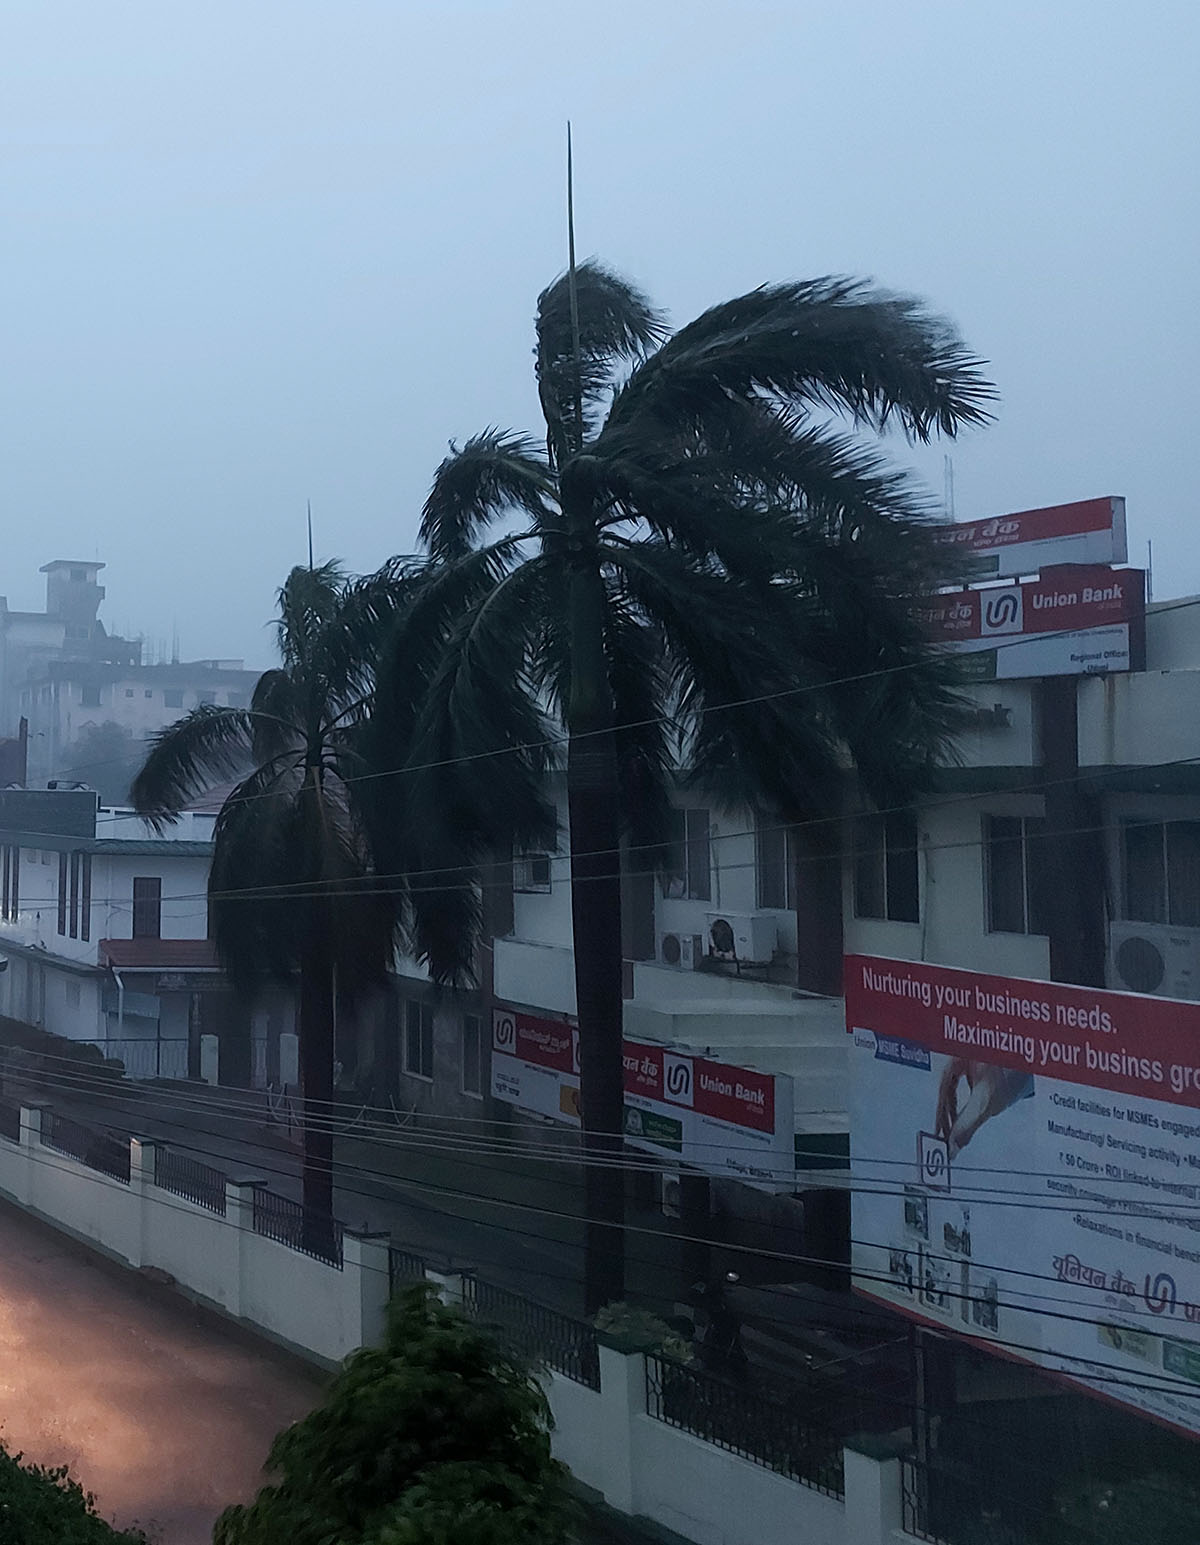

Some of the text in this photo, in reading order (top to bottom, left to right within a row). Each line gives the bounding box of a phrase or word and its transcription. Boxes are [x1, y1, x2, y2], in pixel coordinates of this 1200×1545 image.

[1032, 592, 1077, 609] Union
[1081, 583, 1123, 604] Bank
[862, 968, 1118, 1034] Nurturing your business needs.
[943, 1015, 1035, 1063] Maximizing
[1039, 1039, 1081, 1066] your
[1085, 1041, 1164, 1083] businss
[700, 1074, 765, 1106] Union Bank
[1113, 1106, 1125, 1120] for
[1126, 1108, 1159, 1129] MSMEs
[1106, 1134, 1147, 1159] Servicing
[1148, 1147, 1180, 1167] activity
[1052, 1254, 1107, 1289] यूनियन
